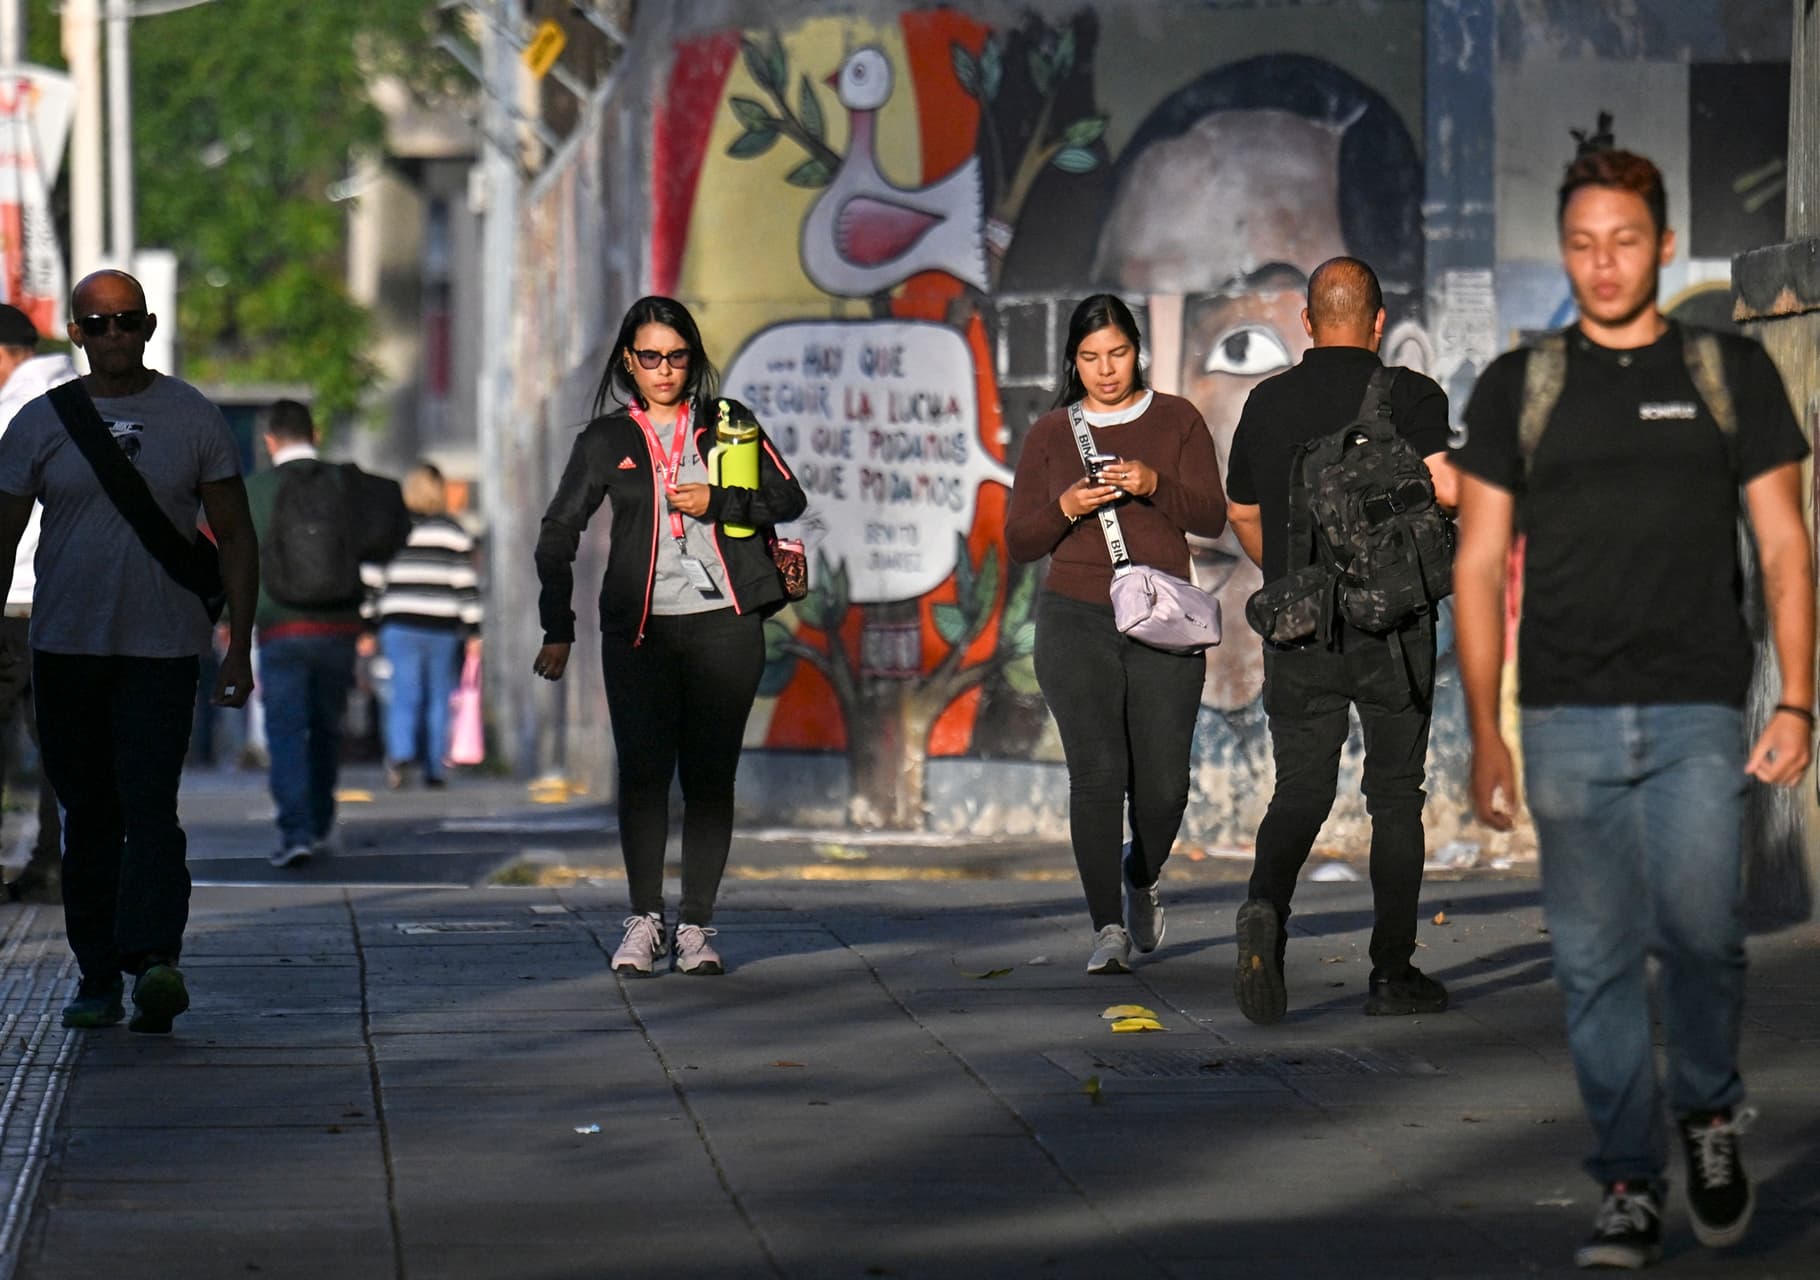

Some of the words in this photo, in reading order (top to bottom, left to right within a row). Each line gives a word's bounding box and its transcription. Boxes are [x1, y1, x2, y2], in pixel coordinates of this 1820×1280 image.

[859, 346, 905, 378] QUE
[844, 387, 874, 421] LA
[888, 392, 961, 424] LUCHA
[811, 425, 854, 460] QUE
[801, 463, 847, 500] QUE
